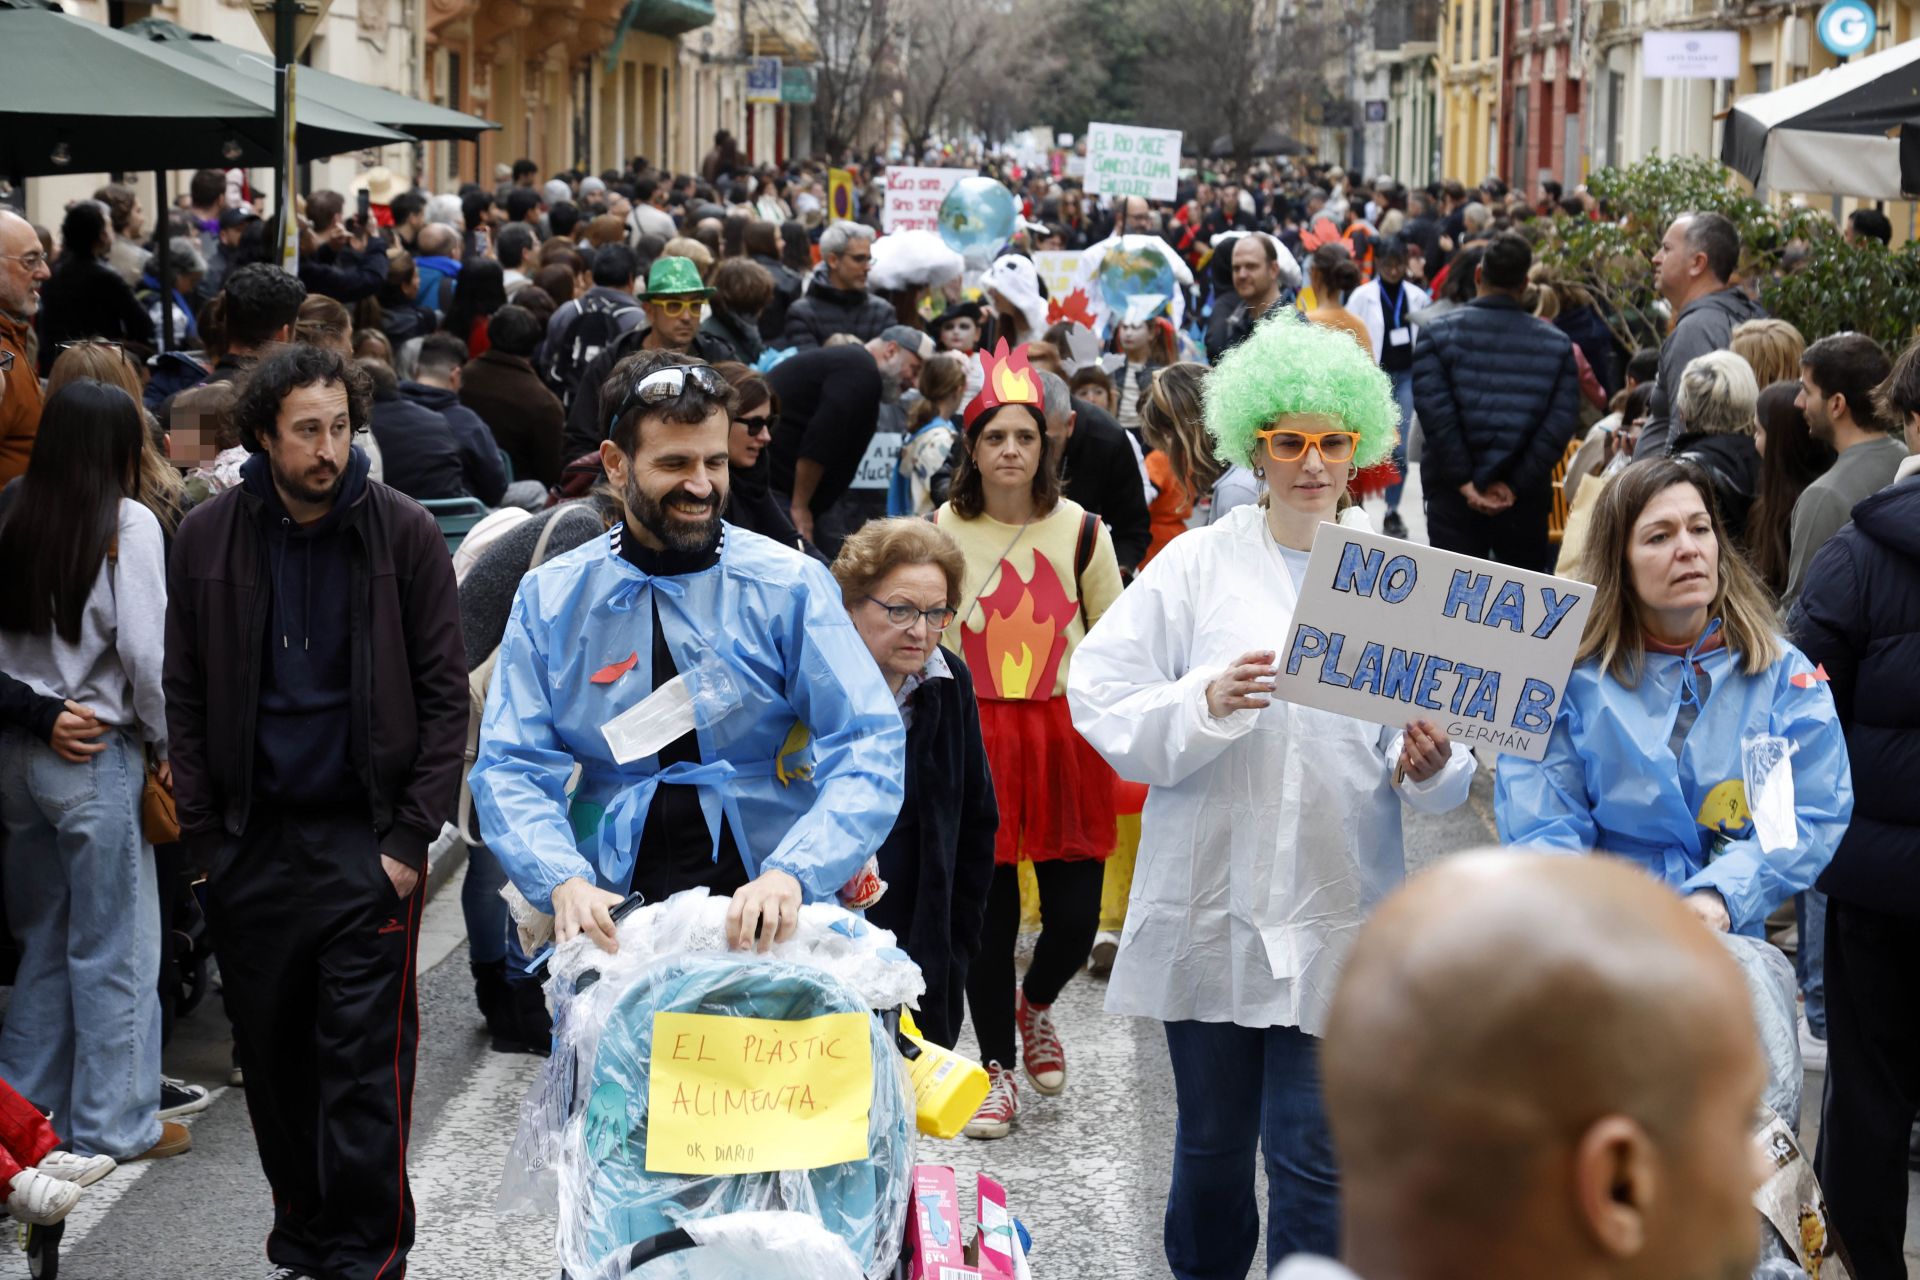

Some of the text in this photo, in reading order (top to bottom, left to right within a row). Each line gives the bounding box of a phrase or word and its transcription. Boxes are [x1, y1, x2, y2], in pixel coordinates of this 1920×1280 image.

[1829, 6, 1867, 47] G
[1332, 541, 1580, 640] NO HAY
[1286, 623, 1556, 735] PLANETA B
[1446, 721, 1531, 751] GERMÁN
[672, 1033, 716, 1061] EL
[687, 1144, 706, 1162] OK
